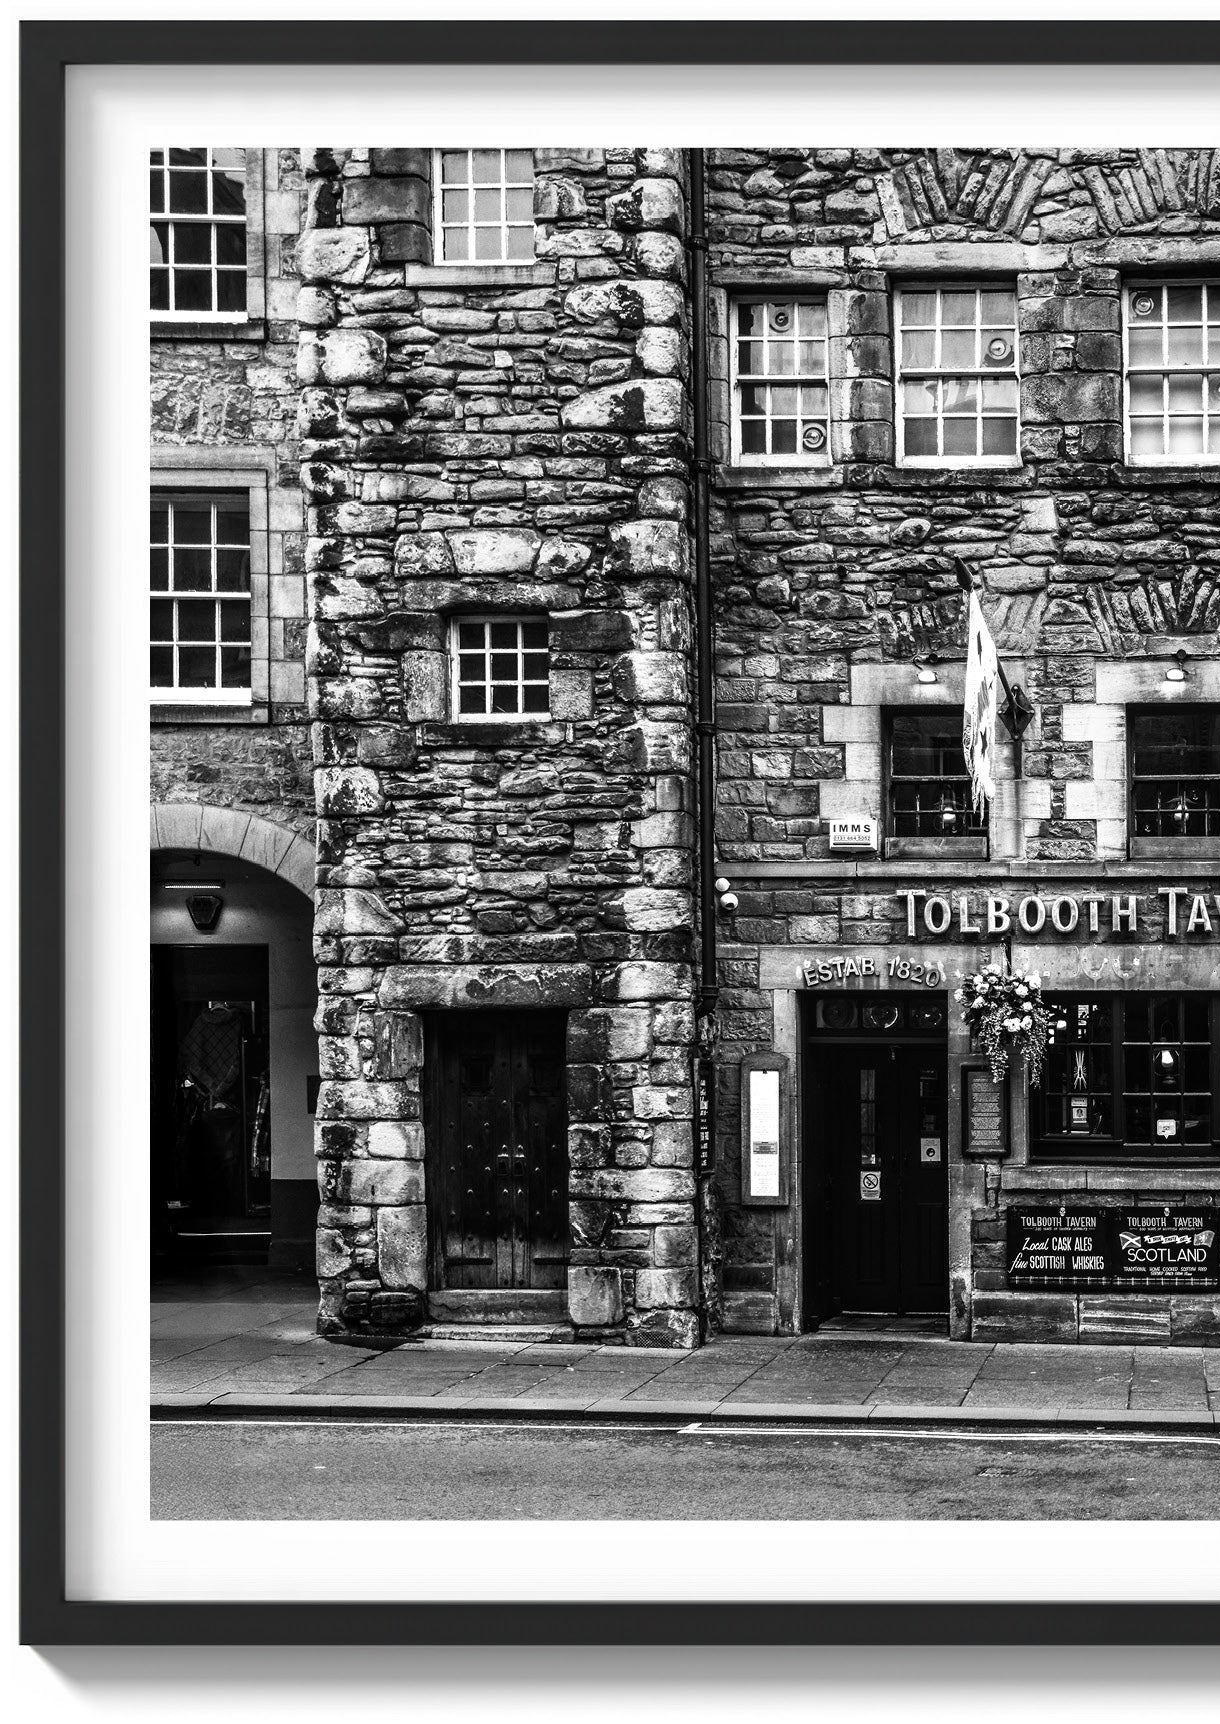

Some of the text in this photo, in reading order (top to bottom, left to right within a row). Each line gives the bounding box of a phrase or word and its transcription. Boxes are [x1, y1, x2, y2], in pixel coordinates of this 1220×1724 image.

[833, 824, 871, 832] IMMS
[897, 889, 1137, 938] TOLBOOTH
[803, 956, 941, 988] ESTAB. 1820
[1020, 1216, 1097, 1227] TOLBOOTH TAVERN
[1127, 1216, 1203, 1227] TOLBOOTH TAVERN
[1022, 1236, 1093, 1251] Local CASK ALES
[1127, 1248, 1207, 1262] SCOTLAND
[1008, 1252, 1104, 1273] fine SCOTTISH WHISKIES
